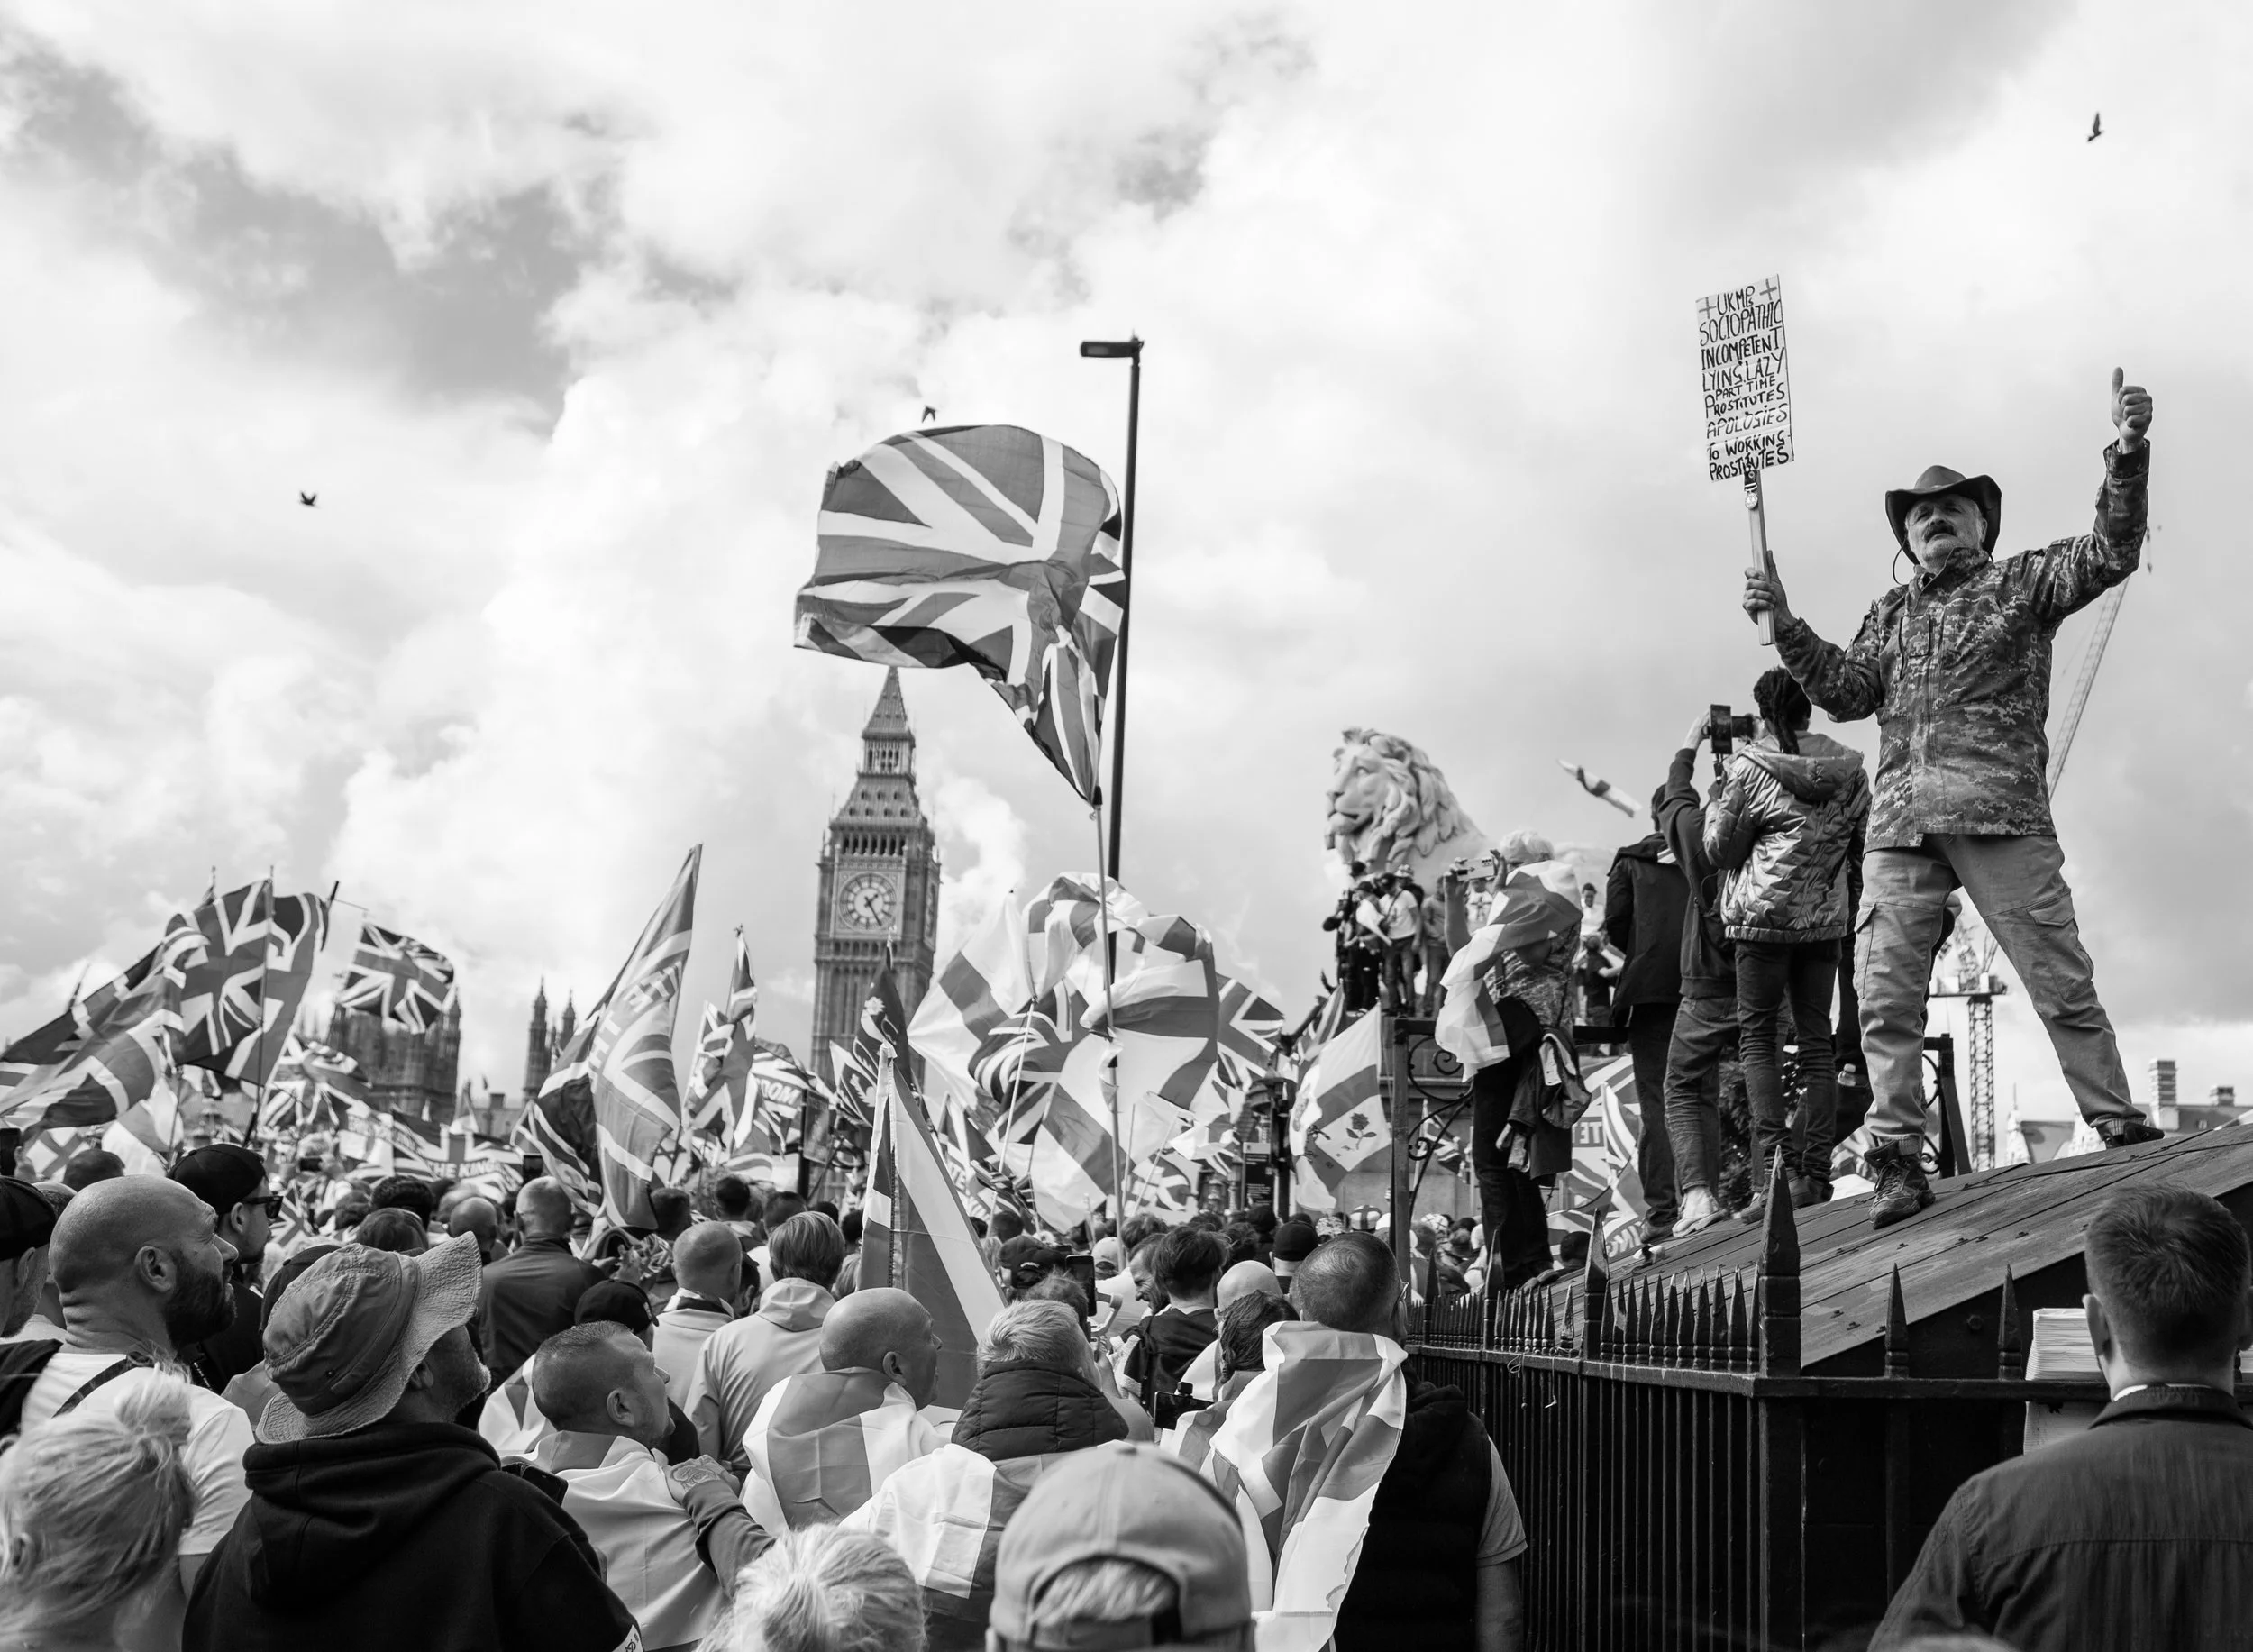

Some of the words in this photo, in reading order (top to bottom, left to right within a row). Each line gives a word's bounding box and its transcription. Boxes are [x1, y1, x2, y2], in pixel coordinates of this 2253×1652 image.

[1699, 298, 1783, 347] SOCIOPATHIC
[1701, 325, 1783, 370] INCOMPETENT
[1745, 346, 1784, 381] LAZY
[1715, 384, 1743, 401] PART
[1746, 375, 1776, 393] TIME
